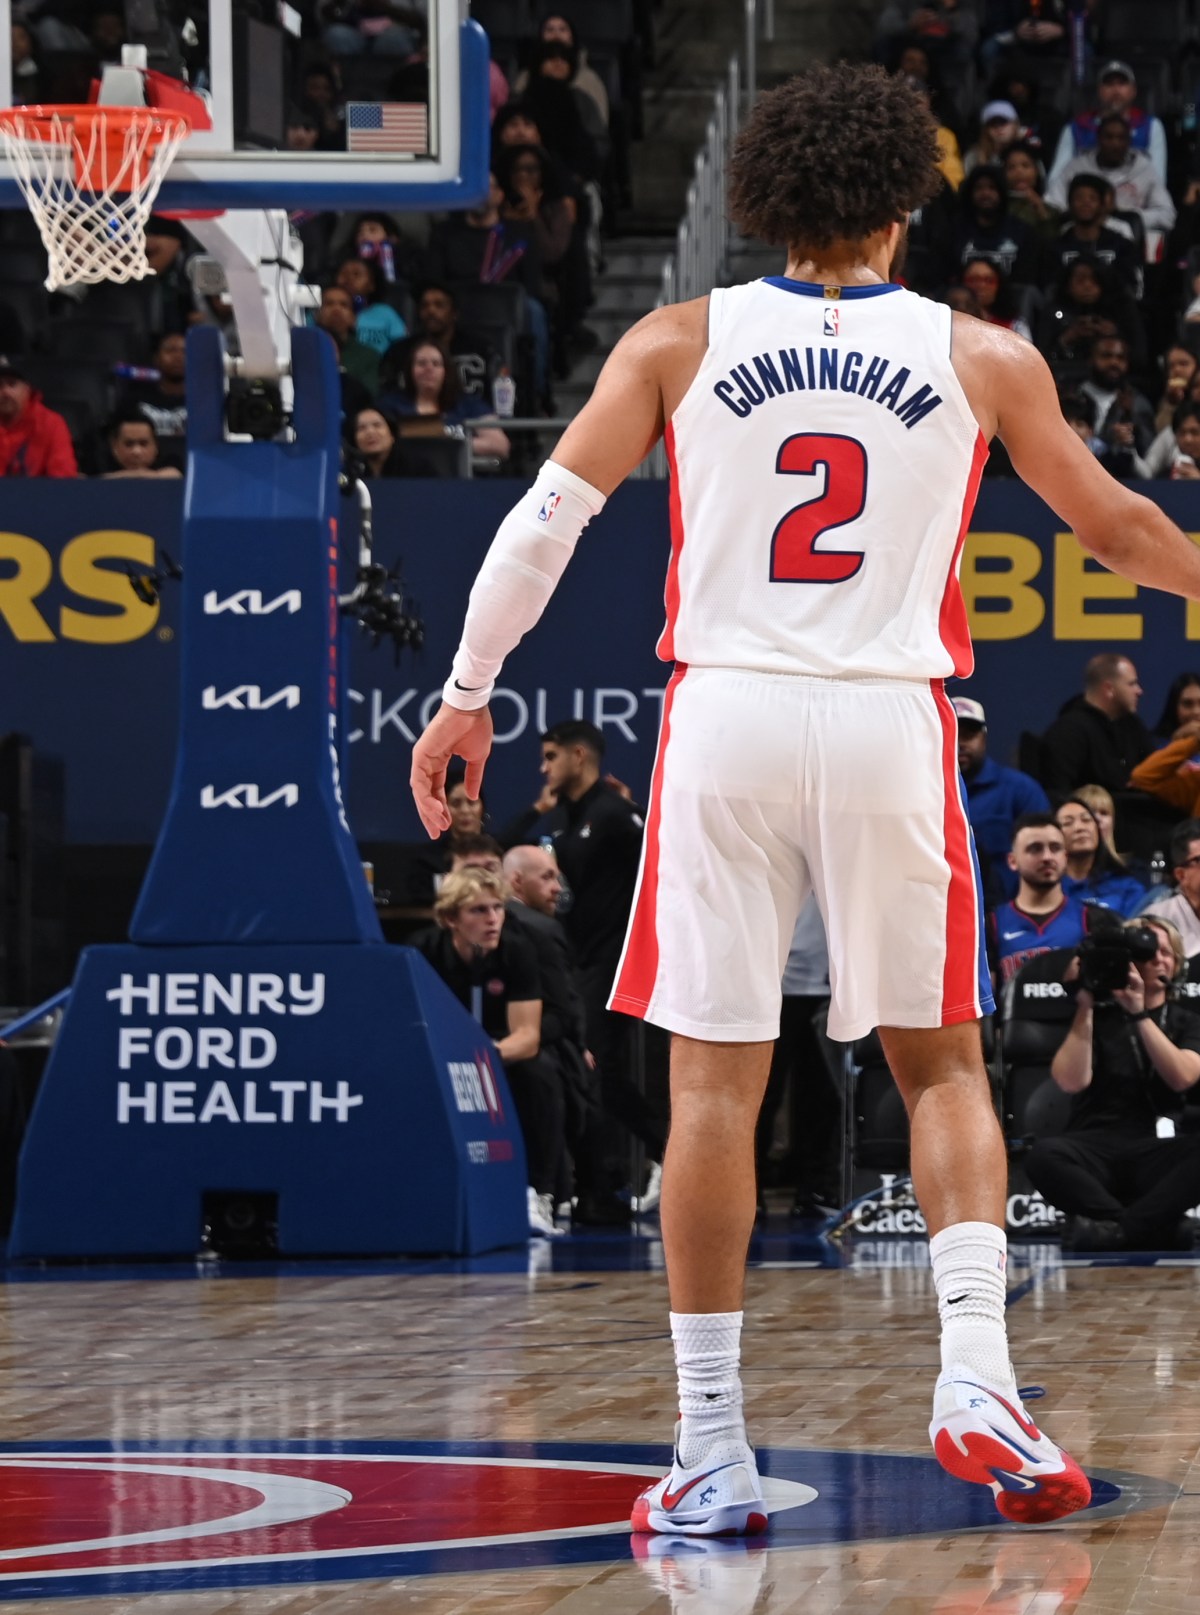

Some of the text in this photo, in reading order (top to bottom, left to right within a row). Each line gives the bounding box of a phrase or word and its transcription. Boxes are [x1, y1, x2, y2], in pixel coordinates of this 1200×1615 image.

[713, 347, 943, 429] CUNNINGHAM
[769, 432, 868, 584] 2
[106, 973, 325, 1015] HENRY
[118, 1027, 277, 1069] FORD
[117, 1081, 363, 1123] HEALTH
